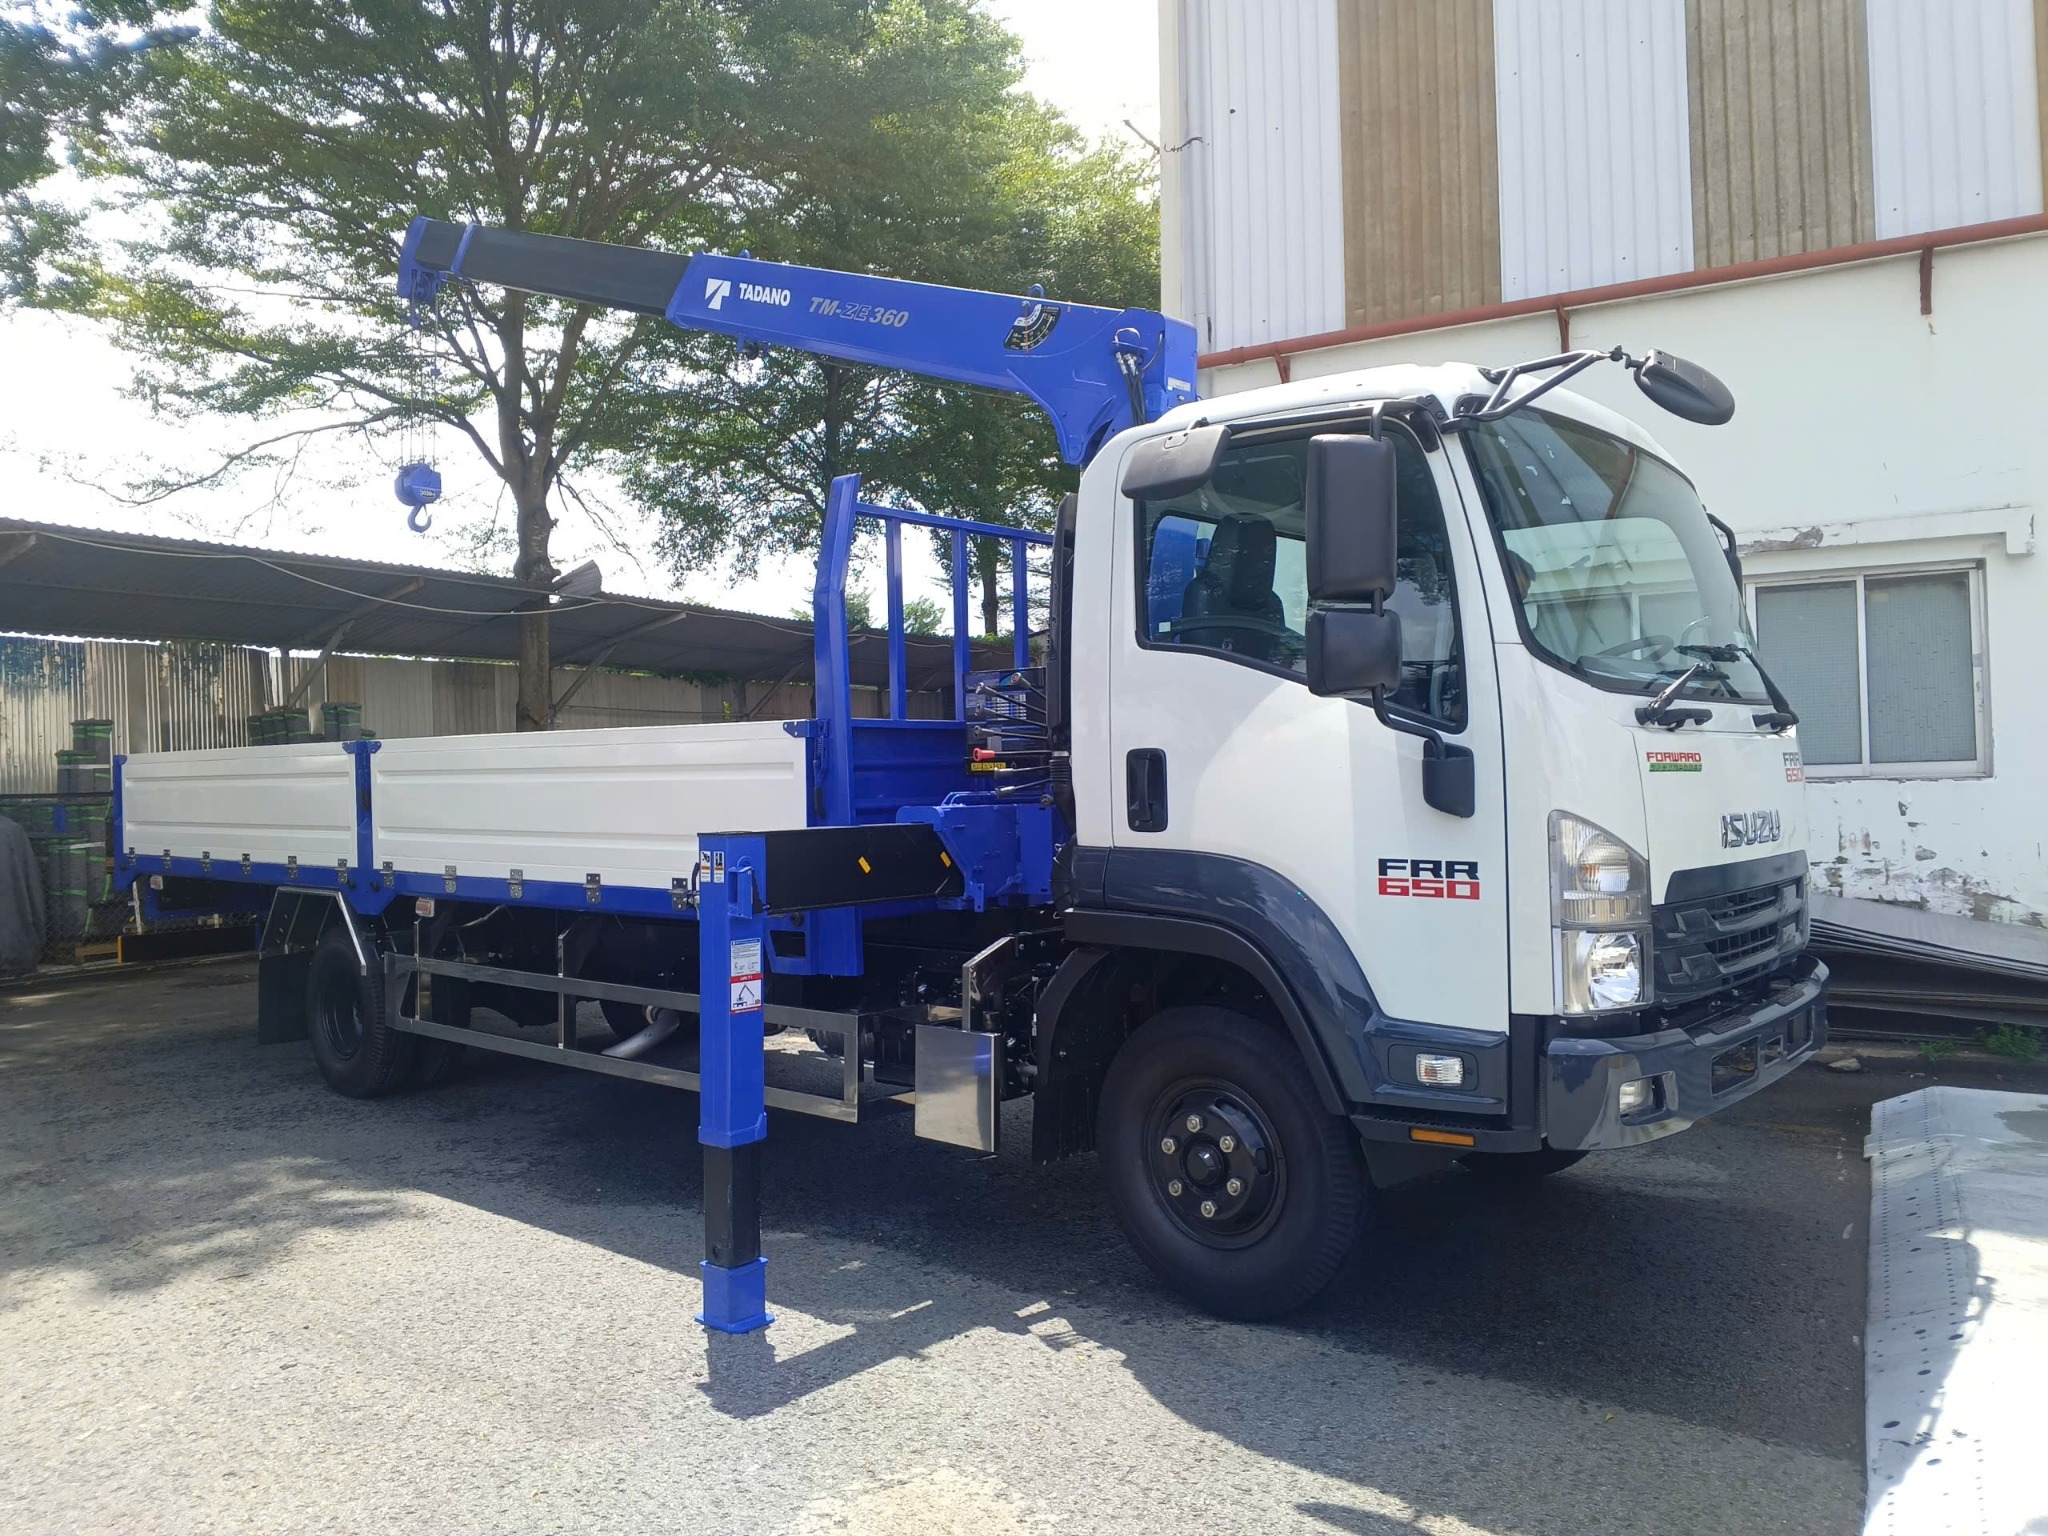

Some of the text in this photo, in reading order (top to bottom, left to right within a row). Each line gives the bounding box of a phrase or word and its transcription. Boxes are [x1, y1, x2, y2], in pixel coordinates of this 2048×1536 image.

[738, 282, 791, 307] TADANO
[1646, 752, 1702, 762] FORWARD
[1782, 752, 1801, 767] FRR
[1720, 809, 1781, 848] ISUZU
[1378, 858, 1480, 880] FRR
[1378, 877, 1480, 900] 650
